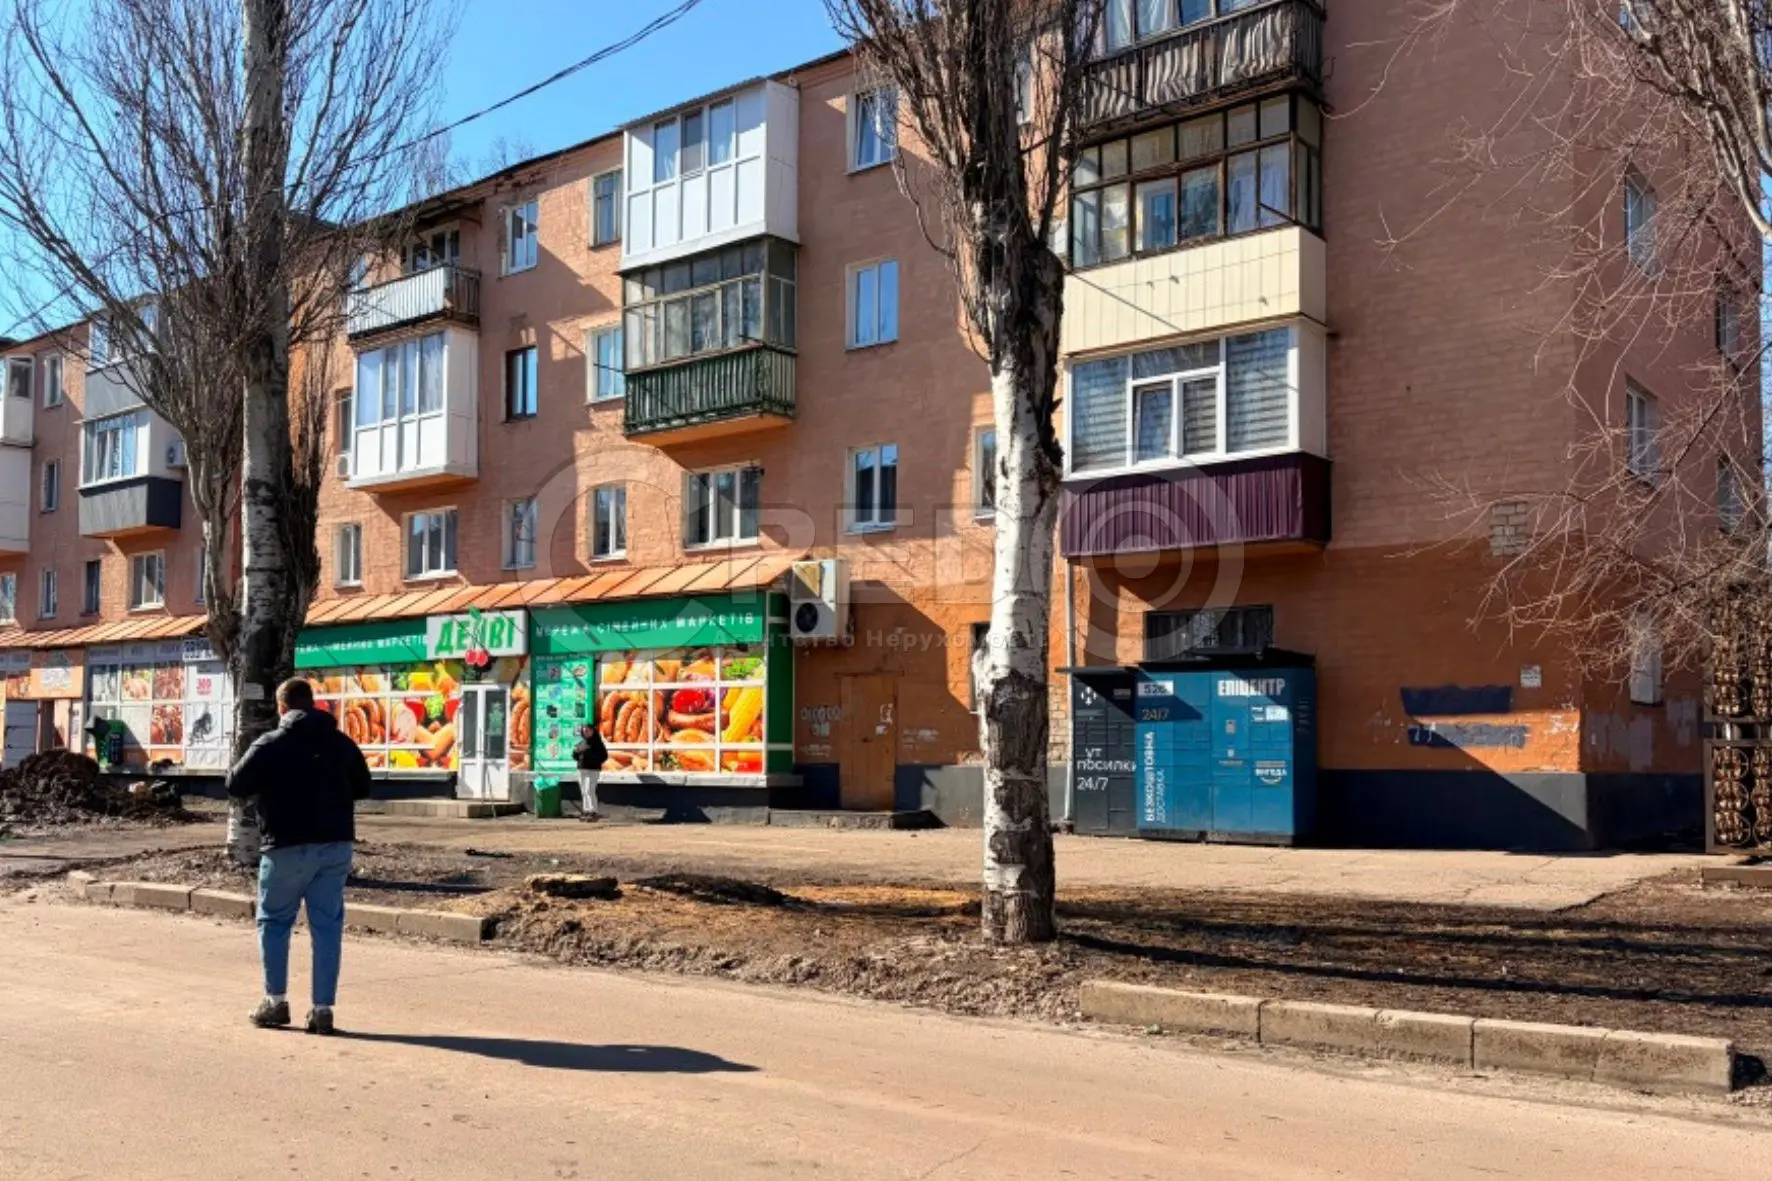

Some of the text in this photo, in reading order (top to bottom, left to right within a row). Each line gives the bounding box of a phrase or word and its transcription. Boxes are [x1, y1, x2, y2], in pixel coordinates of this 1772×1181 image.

[676, 612, 754, 629] МАРКЕТІВ
[1217, 678, 1286, 697] ЕПІЦЕНТР
[1142, 708, 1170, 721] 24/7
[1076, 776, 1109, 792] 24/7
[1144, 731, 1155, 822] БЕЗКОШТОВНА
[1156, 767, 1167, 824] ДОСТАВКА
